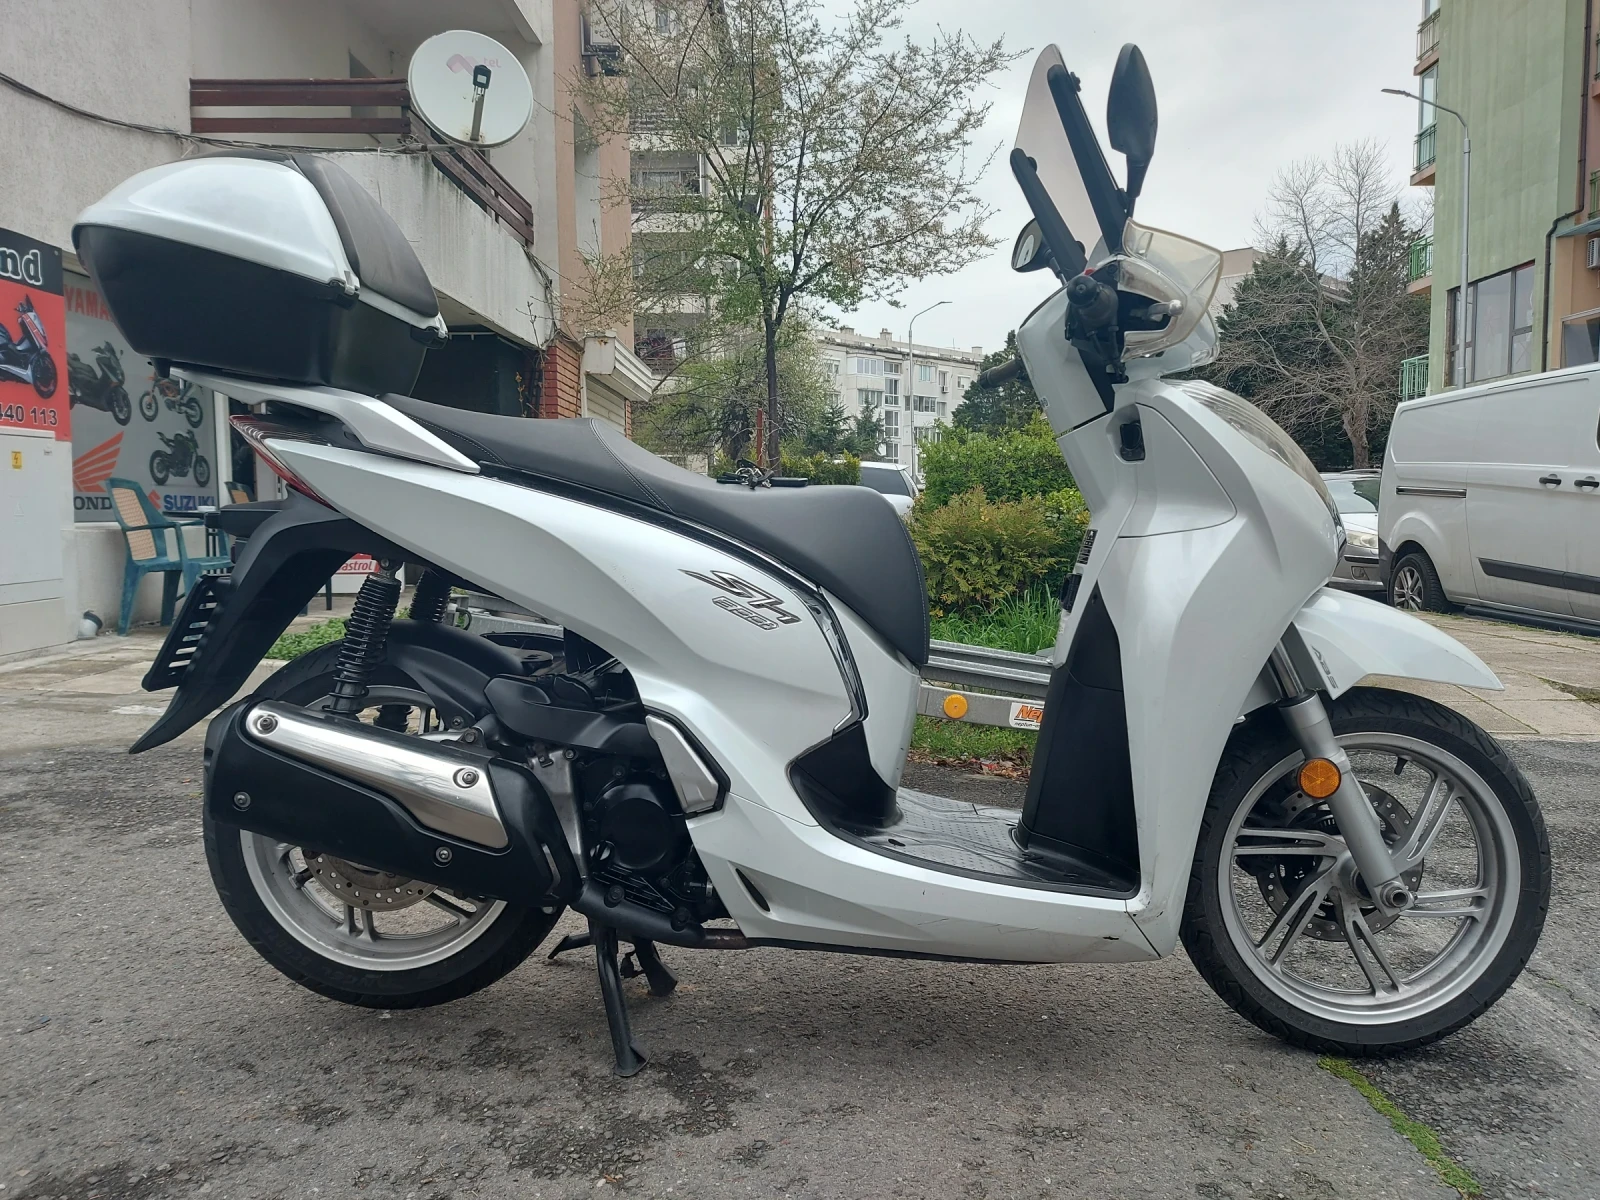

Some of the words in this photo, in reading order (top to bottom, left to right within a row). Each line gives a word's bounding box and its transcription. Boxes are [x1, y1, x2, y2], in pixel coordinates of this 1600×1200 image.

[64, 285, 111, 321] YAMA
[30, 406, 58, 427] 113
[73, 496, 112, 510] OND
[341, 561, 373, 571] astrol
[677, 568, 802, 625] SH
